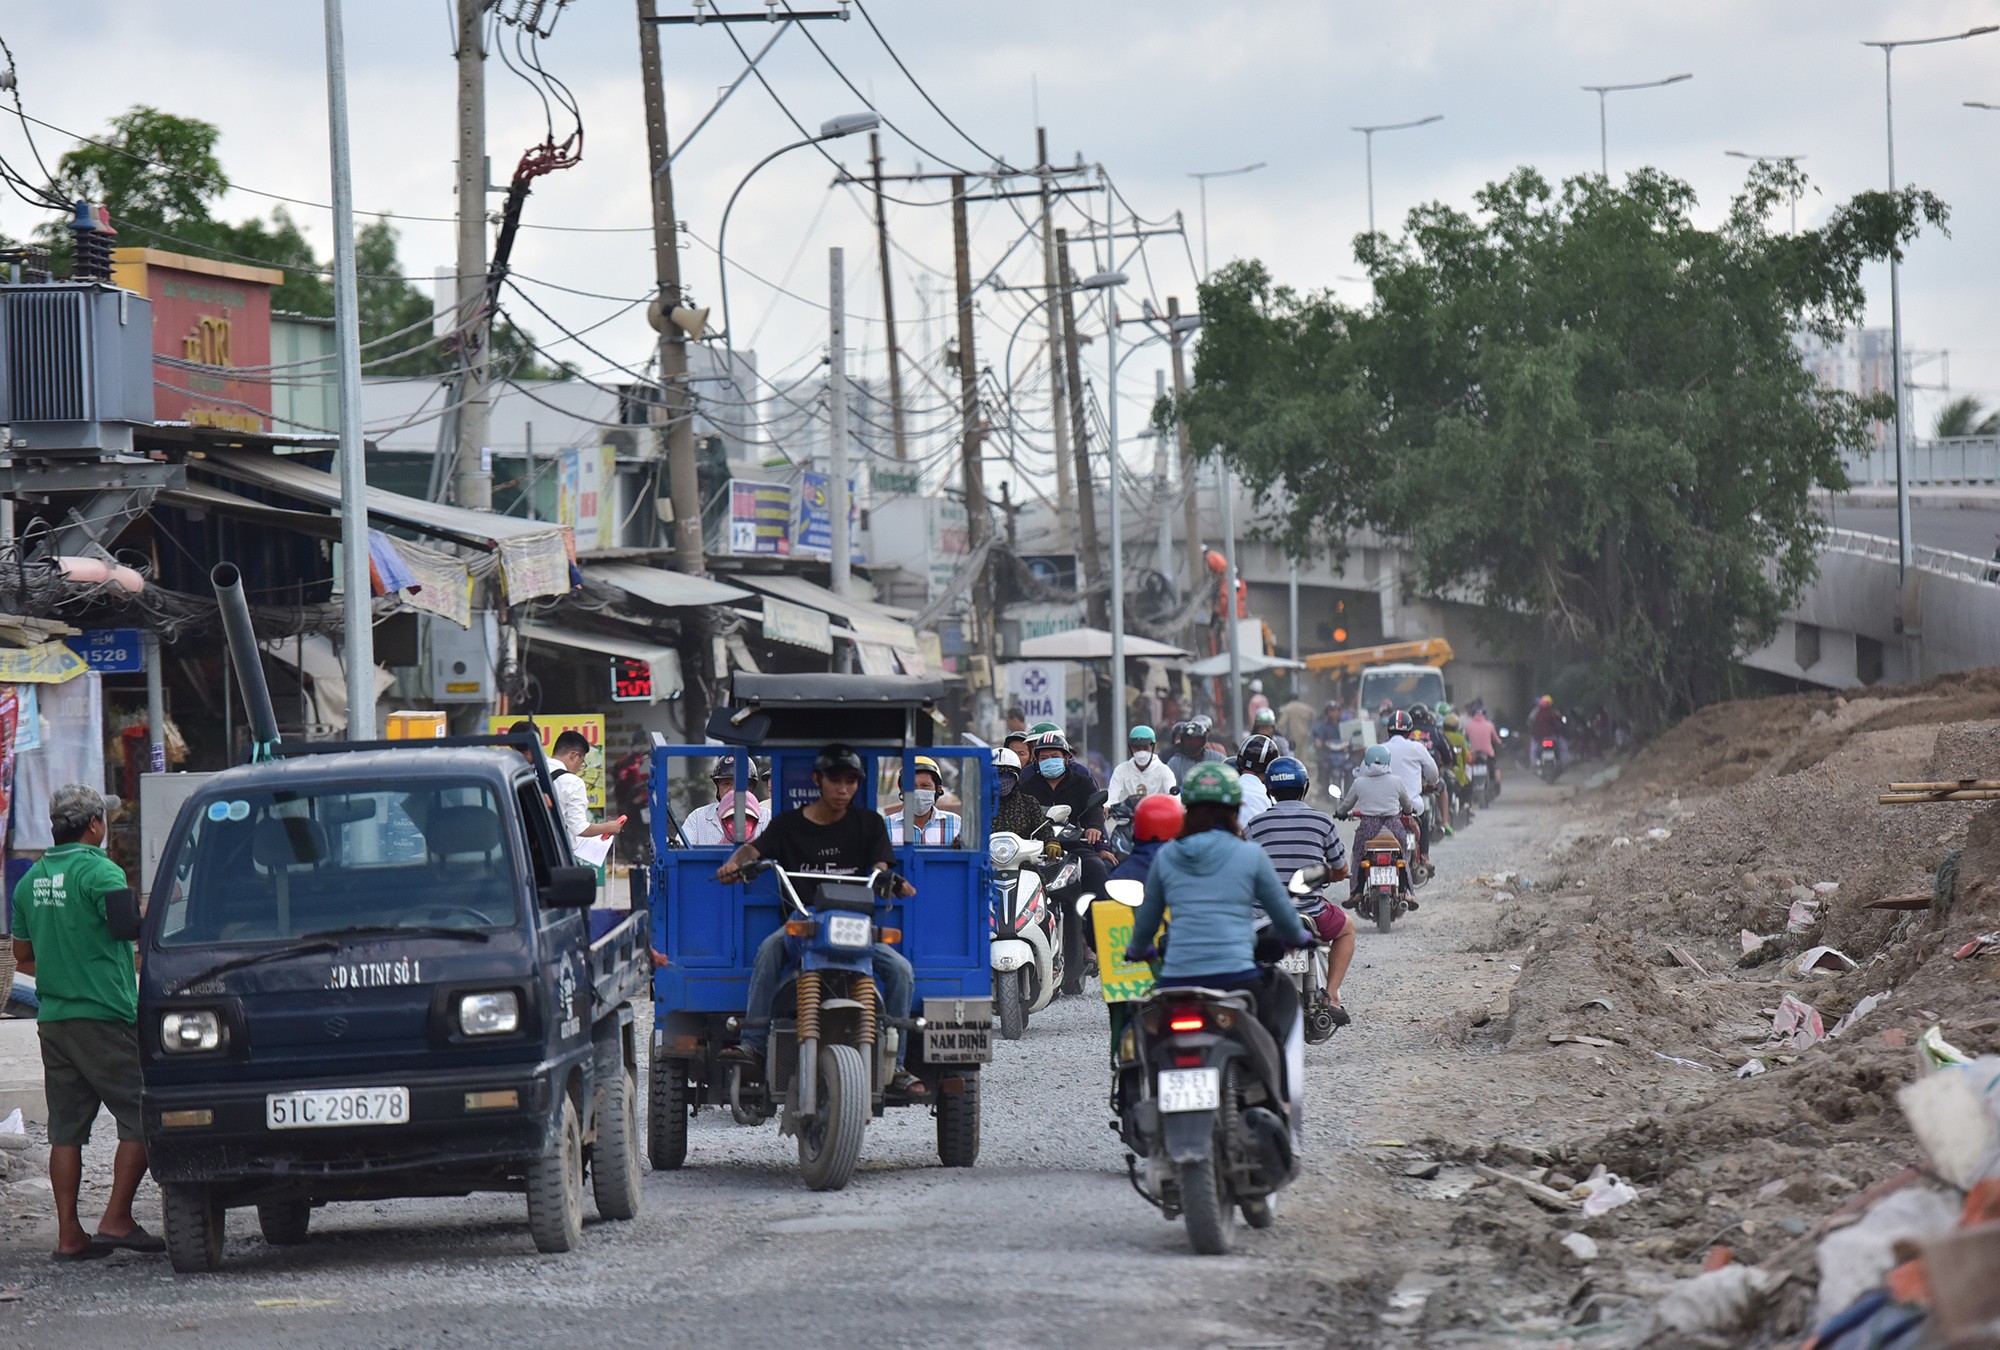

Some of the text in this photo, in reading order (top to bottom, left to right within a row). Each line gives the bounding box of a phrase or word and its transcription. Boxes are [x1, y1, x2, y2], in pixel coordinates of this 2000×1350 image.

[81, 648, 128, 662] 1528
[350, 965, 360, 988] &
[360, 962, 391, 987] TTNT
[413, 960, 420, 984] 1
[929, 1033, 956, 1049] NAM
